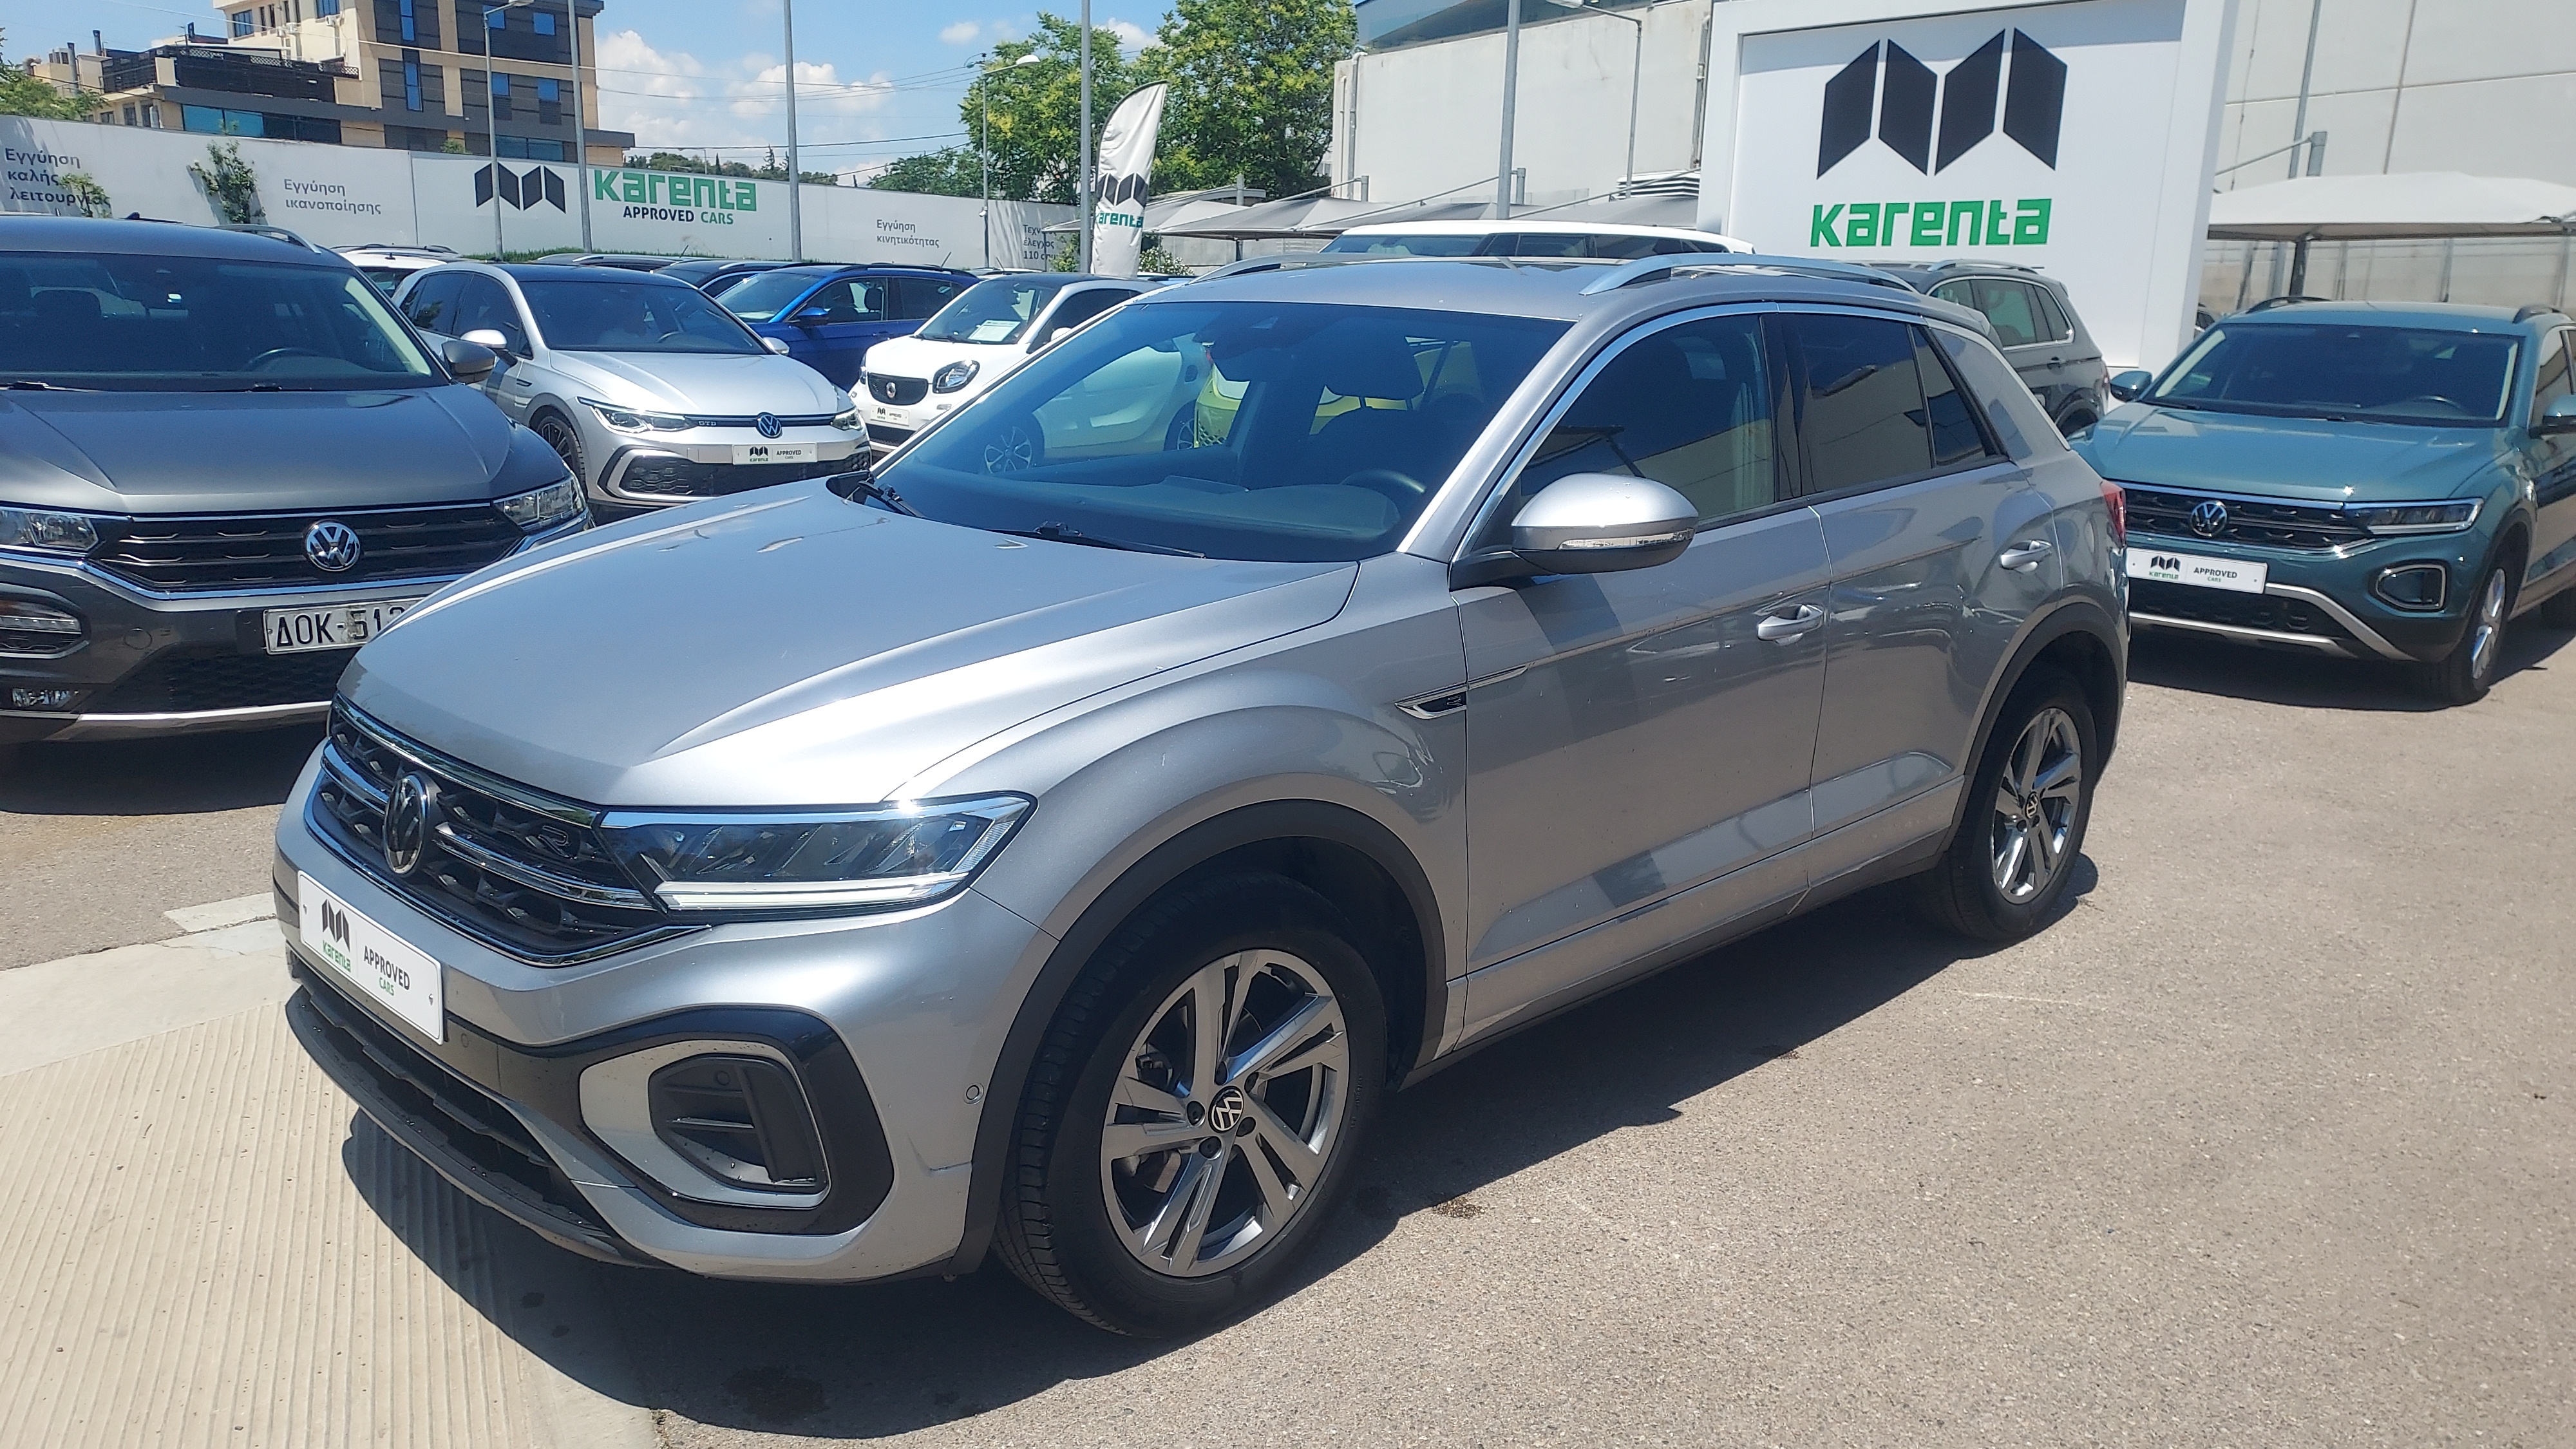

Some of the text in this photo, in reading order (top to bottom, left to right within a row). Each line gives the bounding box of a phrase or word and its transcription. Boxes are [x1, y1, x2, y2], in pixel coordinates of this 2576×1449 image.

[5, 147, 80, 169] Εγγύηση
[8, 169, 59, 186] καλής
[284, 178, 345, 196] Εγγύηση
[286, 199, 381, 215] ικανοποίησης
[623, 205, 734, 225] APPROVED CARS
[876, 219, 916, 233] Εγγύηση
[876, 234, 940, 249] κινητικότητας
[1023, 251, 1039, 260] 110
[2193, 567, 2238, 579] APPROVED
[364, 945, 410, 990] APPROVED
[379, 976, 394, 996] CARS
